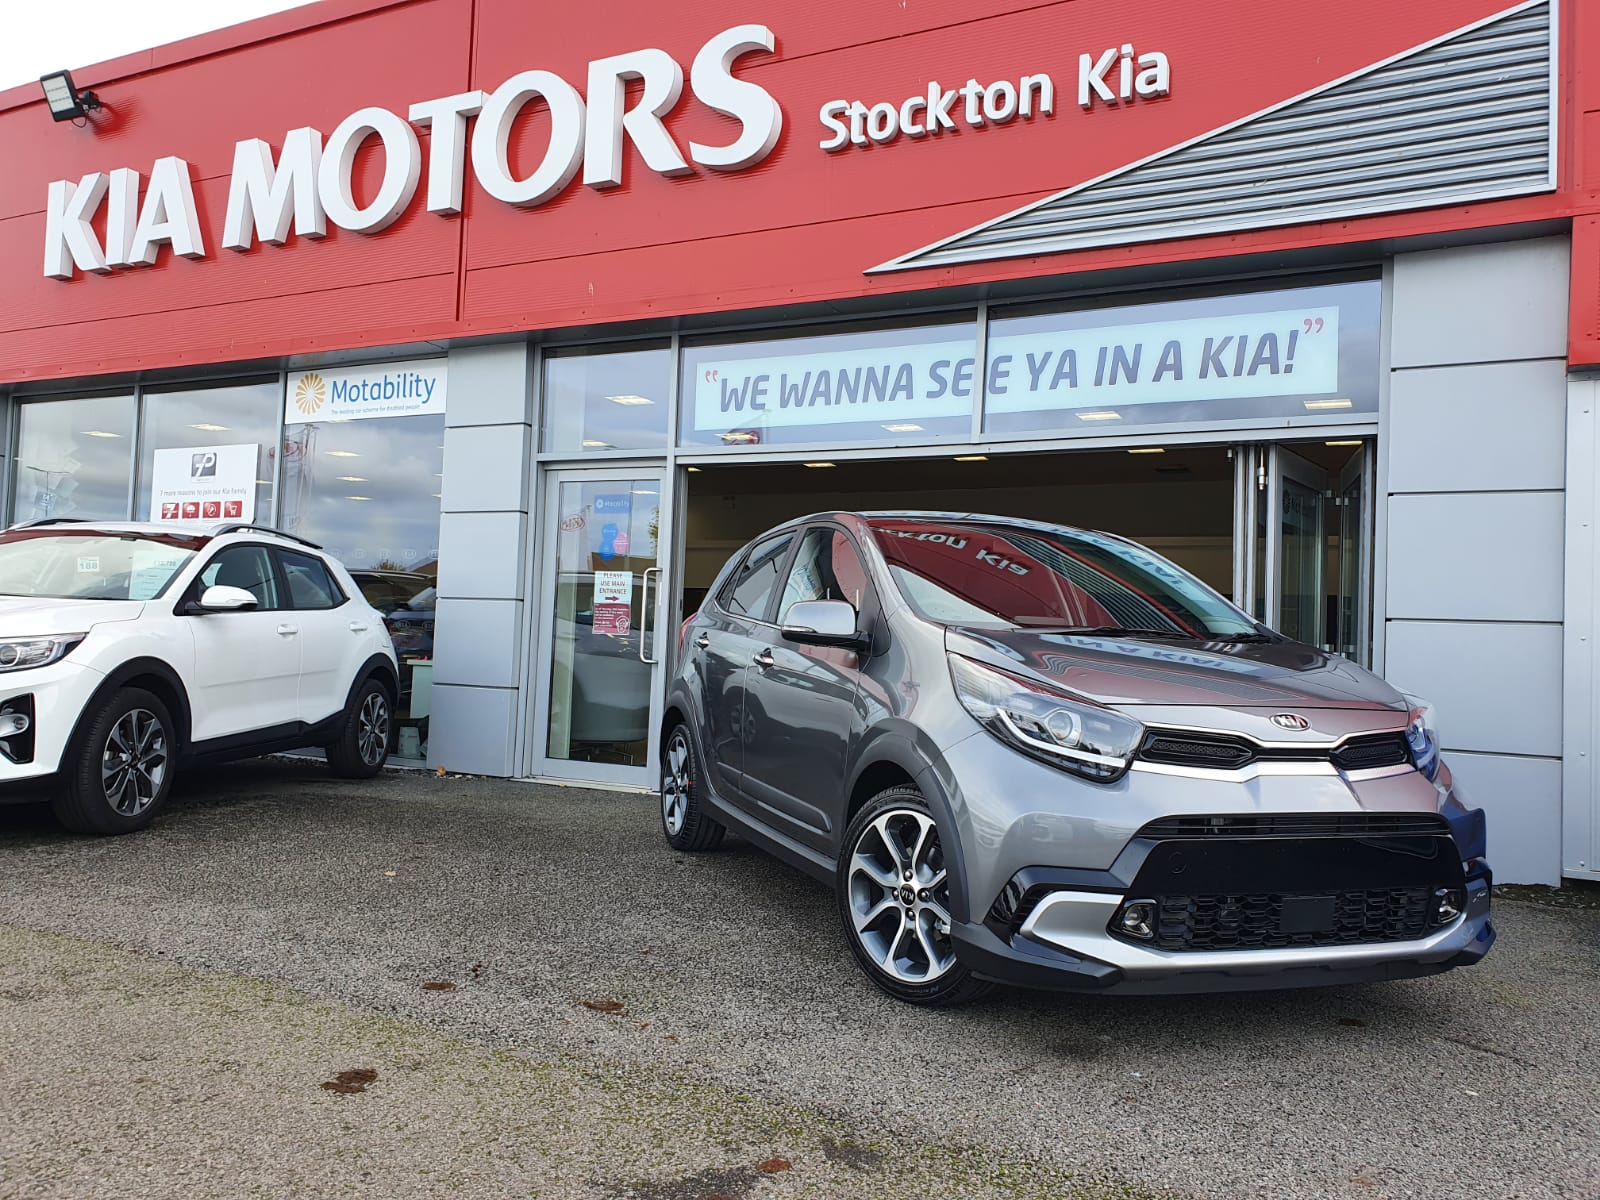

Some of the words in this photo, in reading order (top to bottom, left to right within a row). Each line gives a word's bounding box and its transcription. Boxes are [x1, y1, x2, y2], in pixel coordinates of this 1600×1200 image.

[819, 72, 1054, 152] Stockton
[1078, 43, 1171, 108] Kia
[43, 156, 206, 280] KIA
[222, 24, 783, 251] MOTORS
[331, 372, 436, 404] Motability
[780, 363, 914, 409] WANNA
[926, 355, 1013, 399] SEE
[1026, 349, 1078, 392] YA
[1095, 343, 1143, 387] IN
[1152, 340, 1183, 382] A
[599, 587, 627, 595] ENTRANCE
[901, 889, 914, 900] KIA
